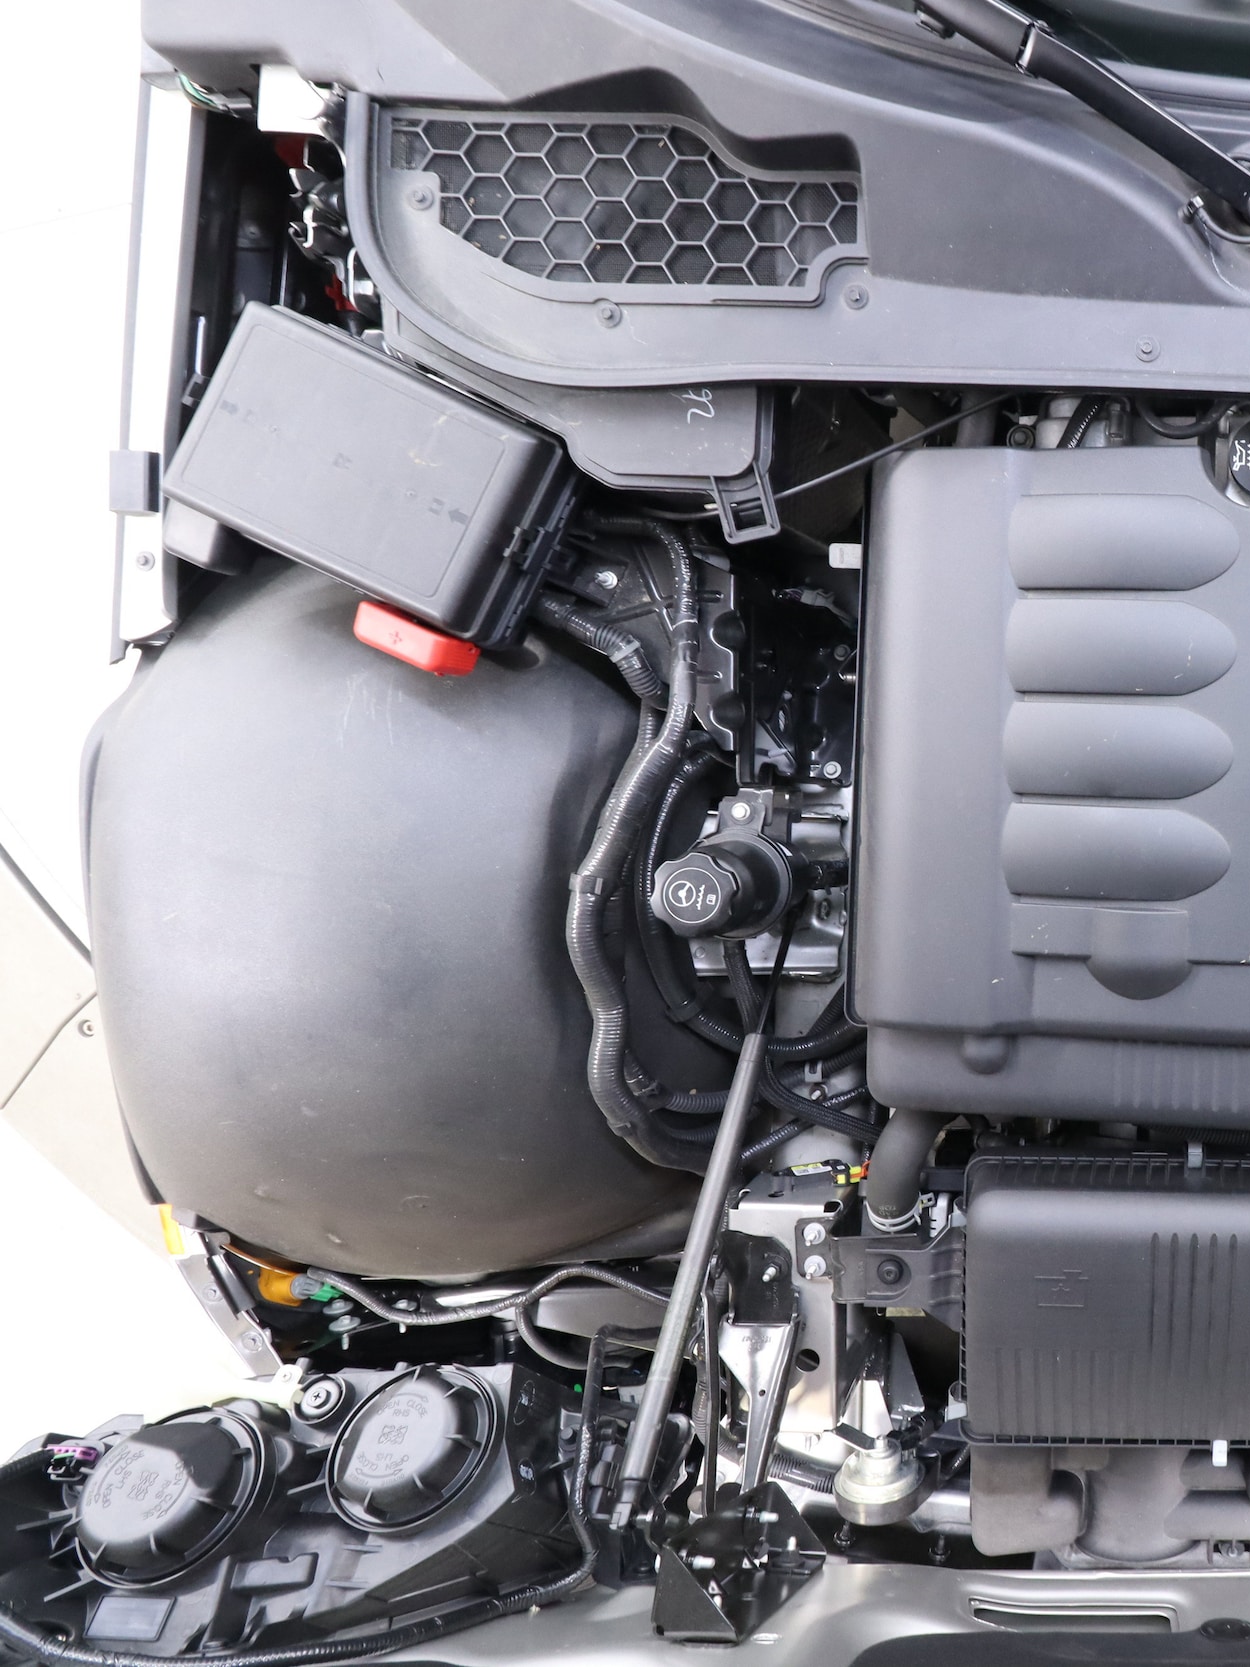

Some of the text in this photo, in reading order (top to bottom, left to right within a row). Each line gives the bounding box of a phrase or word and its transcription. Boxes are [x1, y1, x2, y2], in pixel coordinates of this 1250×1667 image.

[377, 1399, 428, 1418] OPEN CLOSE
[393, 1408, 411, 1417] RHS
[115, 1450, 145, 1475] CLOSE
[357, 1451, 410, 1472] OPEN CLOSE
[376, 1453, 393, 1461] LHS
[115, 1470, 132, 1489] LHS
[101, 1482, 114, 1509] OPEN
